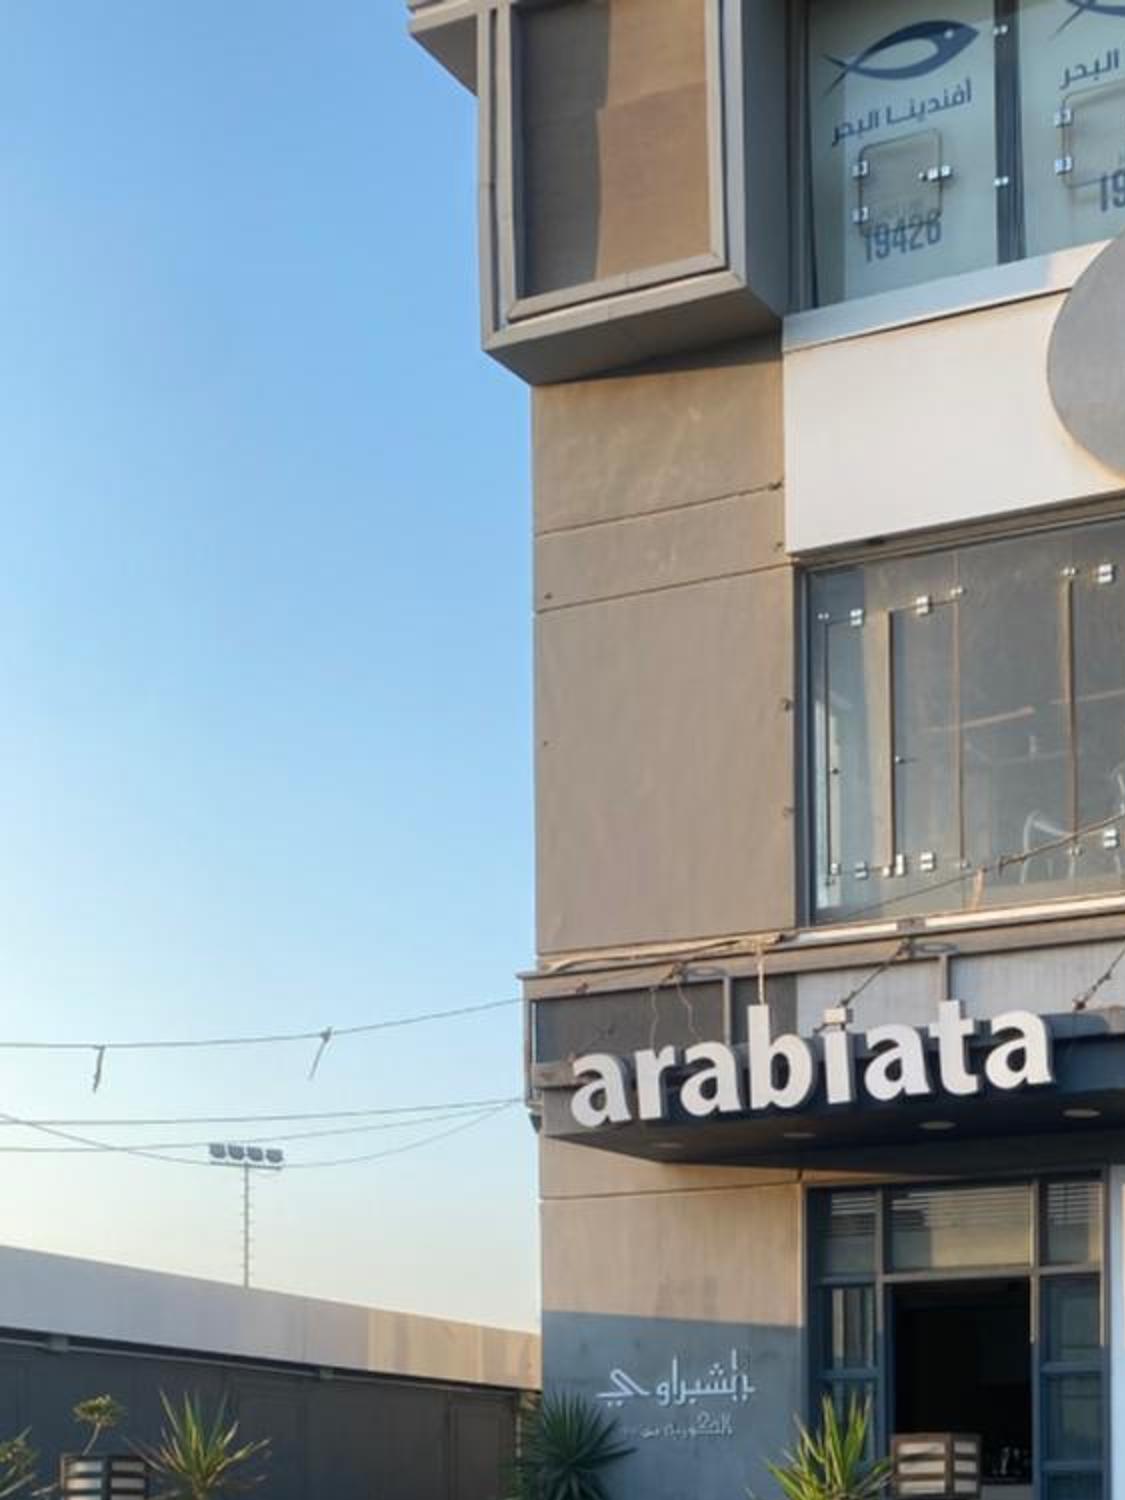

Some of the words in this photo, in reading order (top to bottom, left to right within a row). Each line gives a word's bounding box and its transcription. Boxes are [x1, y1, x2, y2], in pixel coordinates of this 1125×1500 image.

[1060, 49, 1120, 89] البحر
[832, 110, 881, 146] البحر
[569, 1000, 1055, 1129] arabiata
